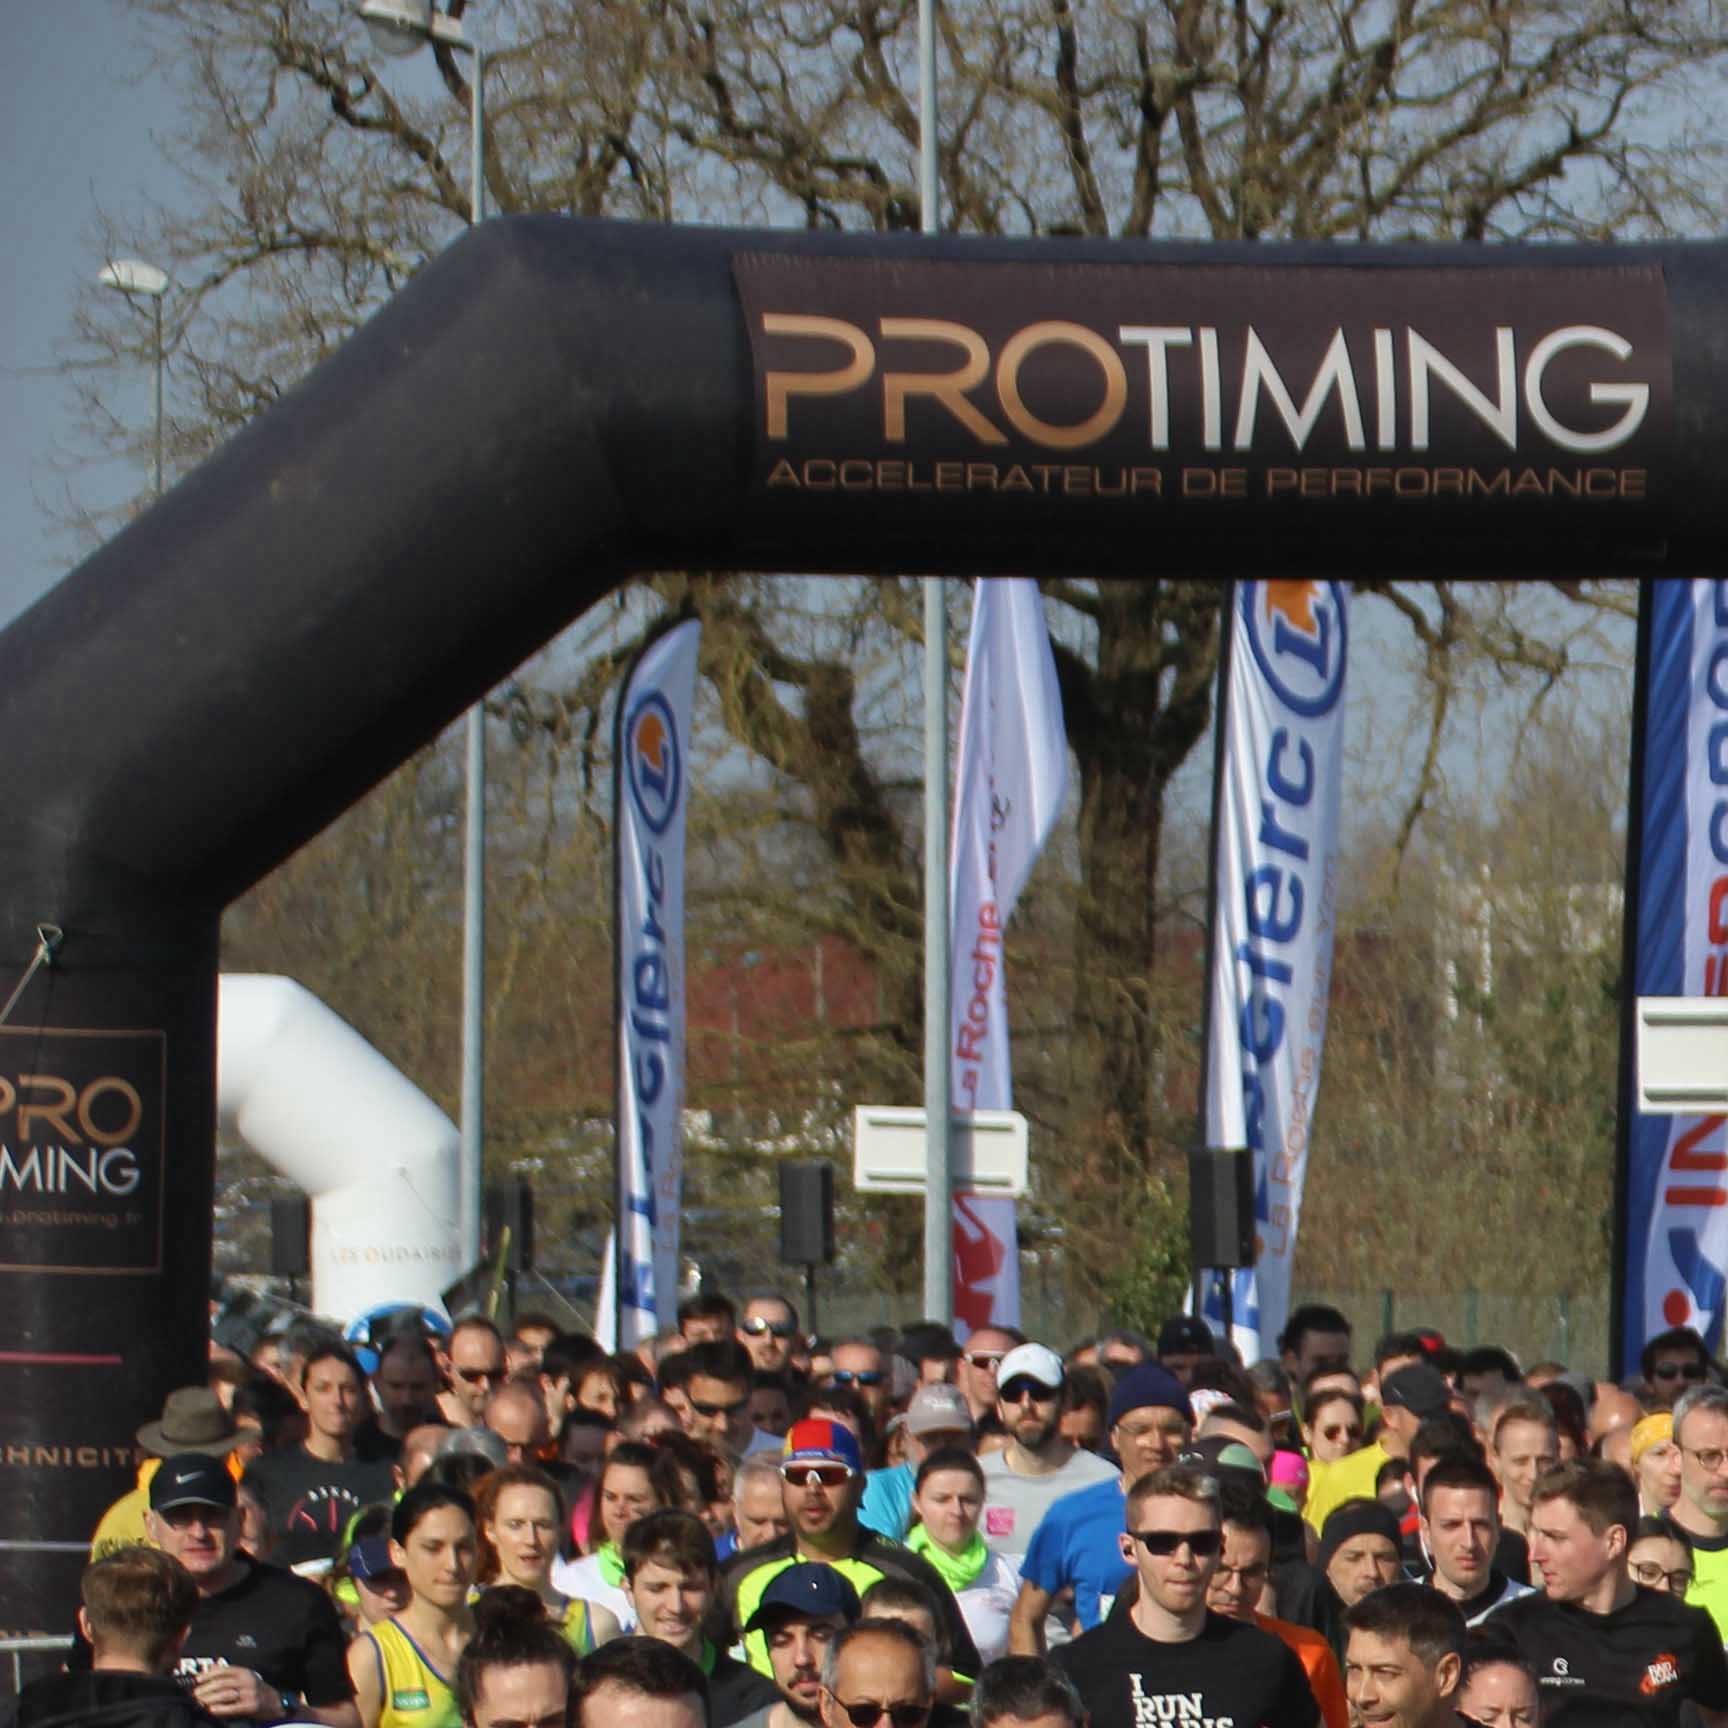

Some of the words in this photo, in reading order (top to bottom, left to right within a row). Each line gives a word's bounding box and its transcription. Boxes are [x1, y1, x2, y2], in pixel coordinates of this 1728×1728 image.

[762, 312, 1650, 453] PROTIMING
[765, 459, 1164, 498] ACCELERATEUR
[1180, 467, 1248, 499] DE
[1266, 466, 1647, 501] PERFORMANCE
[1135, 1691, 1204, 1722] RUN
